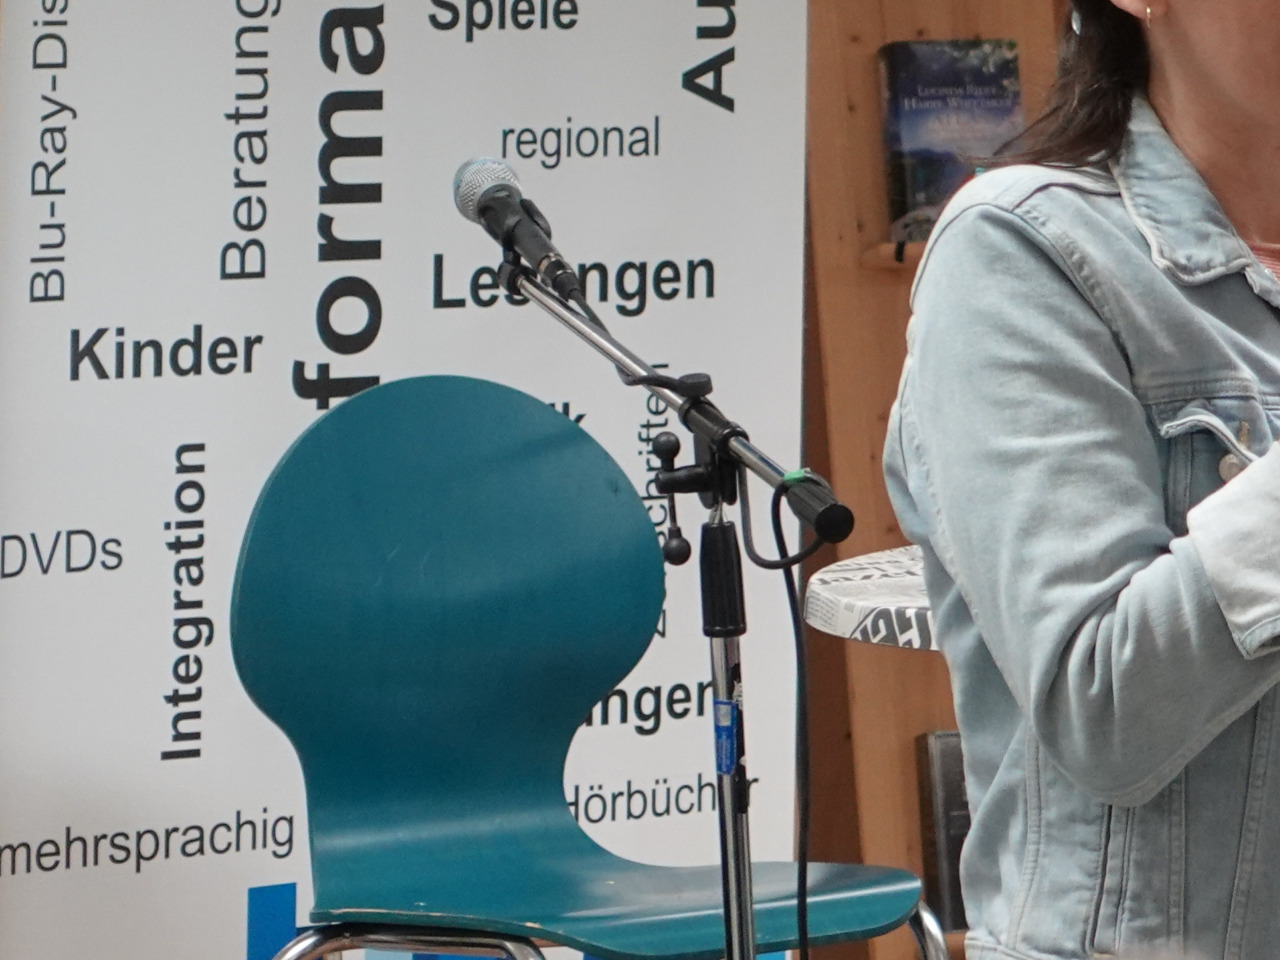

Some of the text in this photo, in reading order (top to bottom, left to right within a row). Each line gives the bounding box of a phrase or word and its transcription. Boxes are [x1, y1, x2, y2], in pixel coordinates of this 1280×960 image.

[501, 116, 660, 170] regional
[433, 253, 715, 317] Lengen
[70, 325, 264, 382] Kinder
[0, 529, 123, 579] DVDs
[161, 442, 215, 761] Integration
[568, 772, 760, 825] Hörbüchr
[0, 807, 294, 876] mehrsprachig
